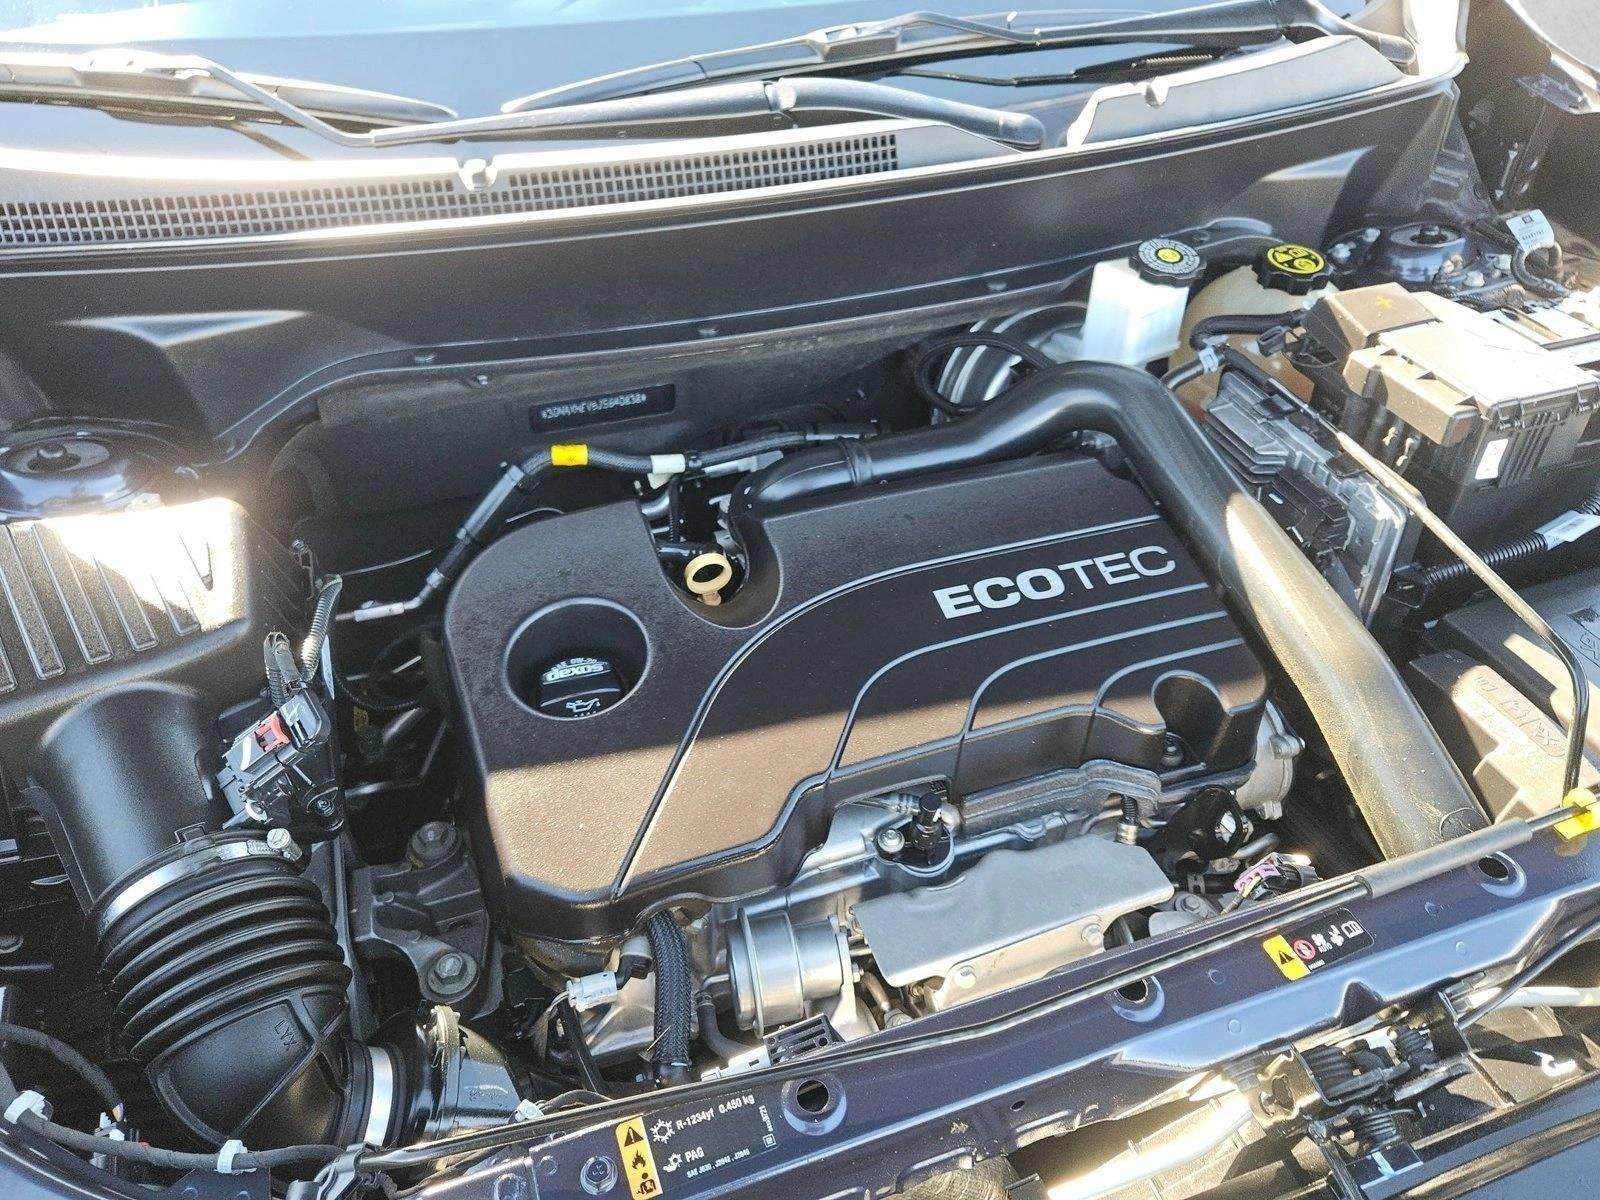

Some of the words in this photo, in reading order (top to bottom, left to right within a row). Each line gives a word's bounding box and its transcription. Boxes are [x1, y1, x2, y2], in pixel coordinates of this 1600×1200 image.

[932, 545, 1176, 619] ECOTEC
[546, 664, 604, 681] dexos
[675, 1107, 715, 1131] R-1234yf
[743, 1094, 756, 1106] kg
[684, 1146, 705, 1163] PAG
